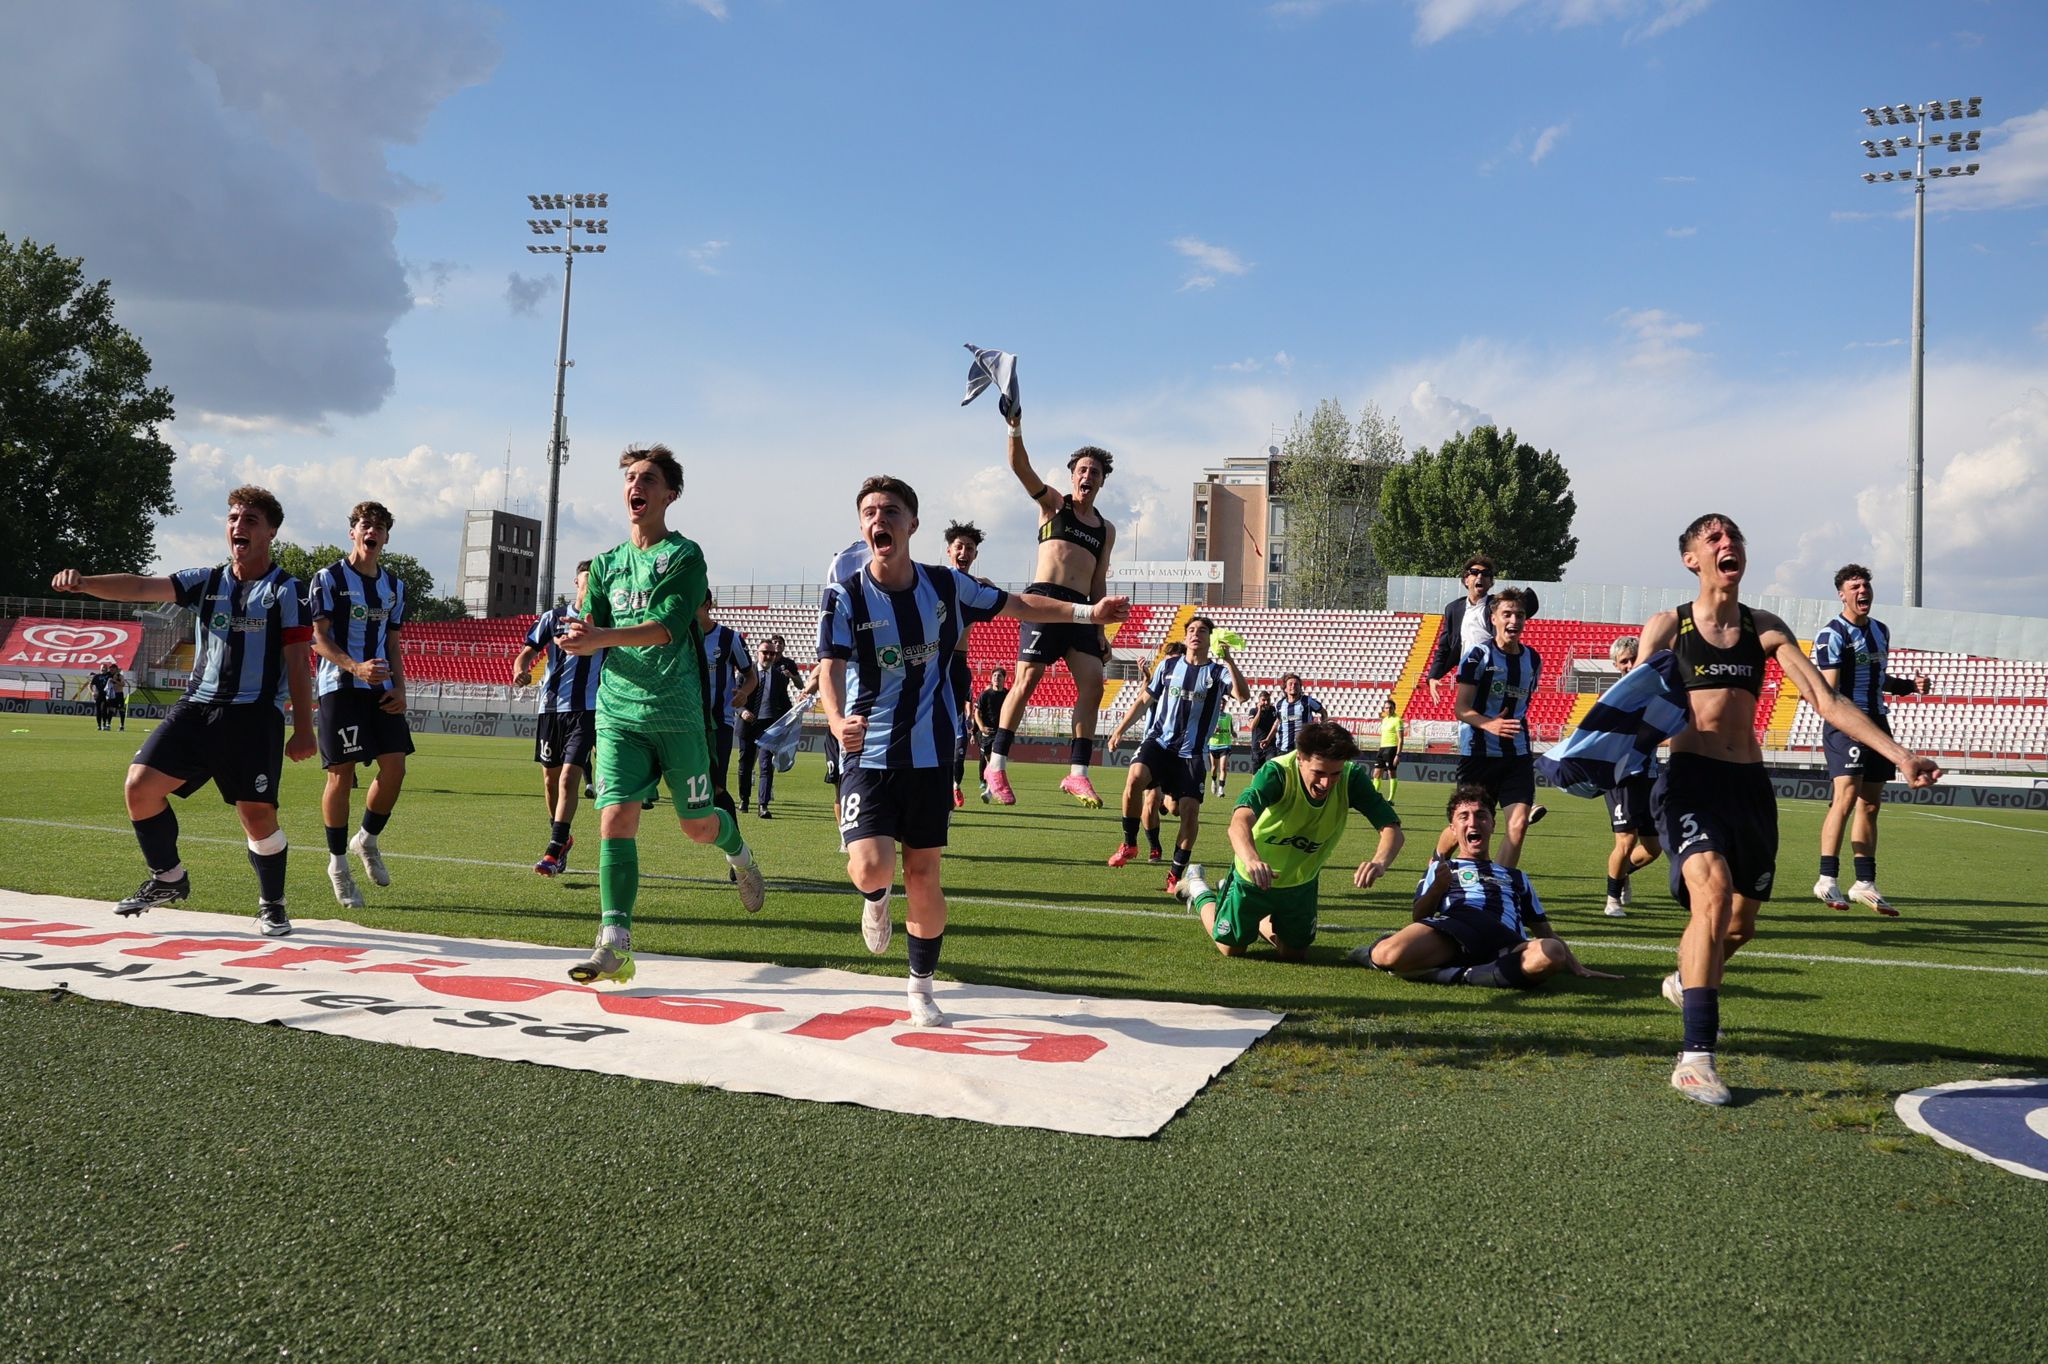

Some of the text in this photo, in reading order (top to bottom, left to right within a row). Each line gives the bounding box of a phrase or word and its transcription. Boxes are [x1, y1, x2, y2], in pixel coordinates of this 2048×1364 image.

[1159, 568, 1202, 576] MANTOVA
[857, 620, 890, 632] LEGEA
[1031, 630, 1042, 649] 7
[8, 650, 117, 664] ALGIDA
[1694, 663, 1753, 677] K-SPORT
[337, 725, 359, 748] 17
[441, 720, 497, 736] VeroDol
[540, 739, 552, 758] 16
[1848, 746, 1860, 763] 9
[687, 773, 710, 803] 12
[1971, 787, 2048, 810] VeroD
[840, 792, 861, 826] 18
[1614, 804, 1624, 820] 4
[1679, 812, 1699, 839] 3
